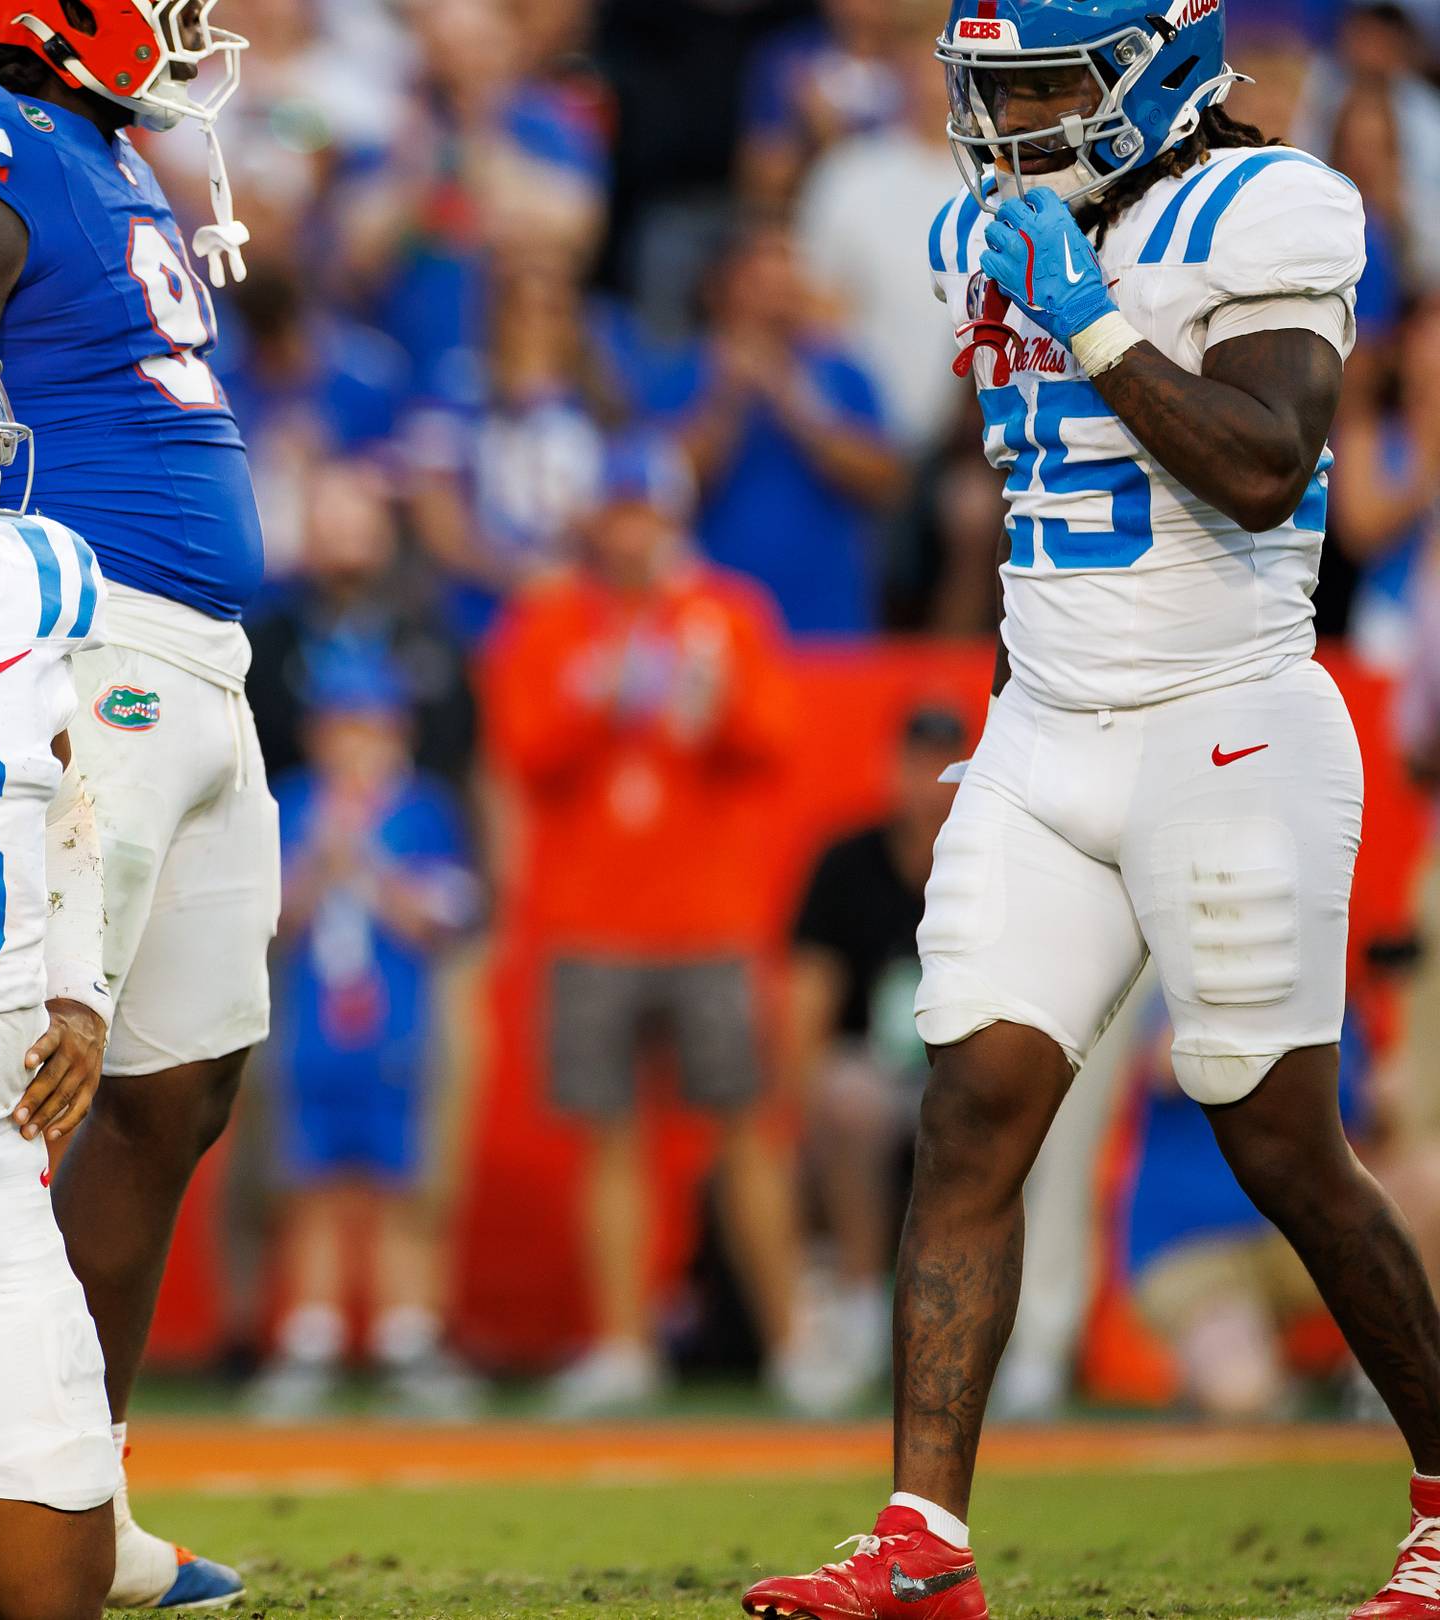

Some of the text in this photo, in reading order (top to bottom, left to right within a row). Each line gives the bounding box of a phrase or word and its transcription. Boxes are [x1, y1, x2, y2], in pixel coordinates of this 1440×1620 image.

[959, 20, 1001, 39] REBS
[125, 216, 228, 412] 9
[1028, 336, 1066, 373] Miss
